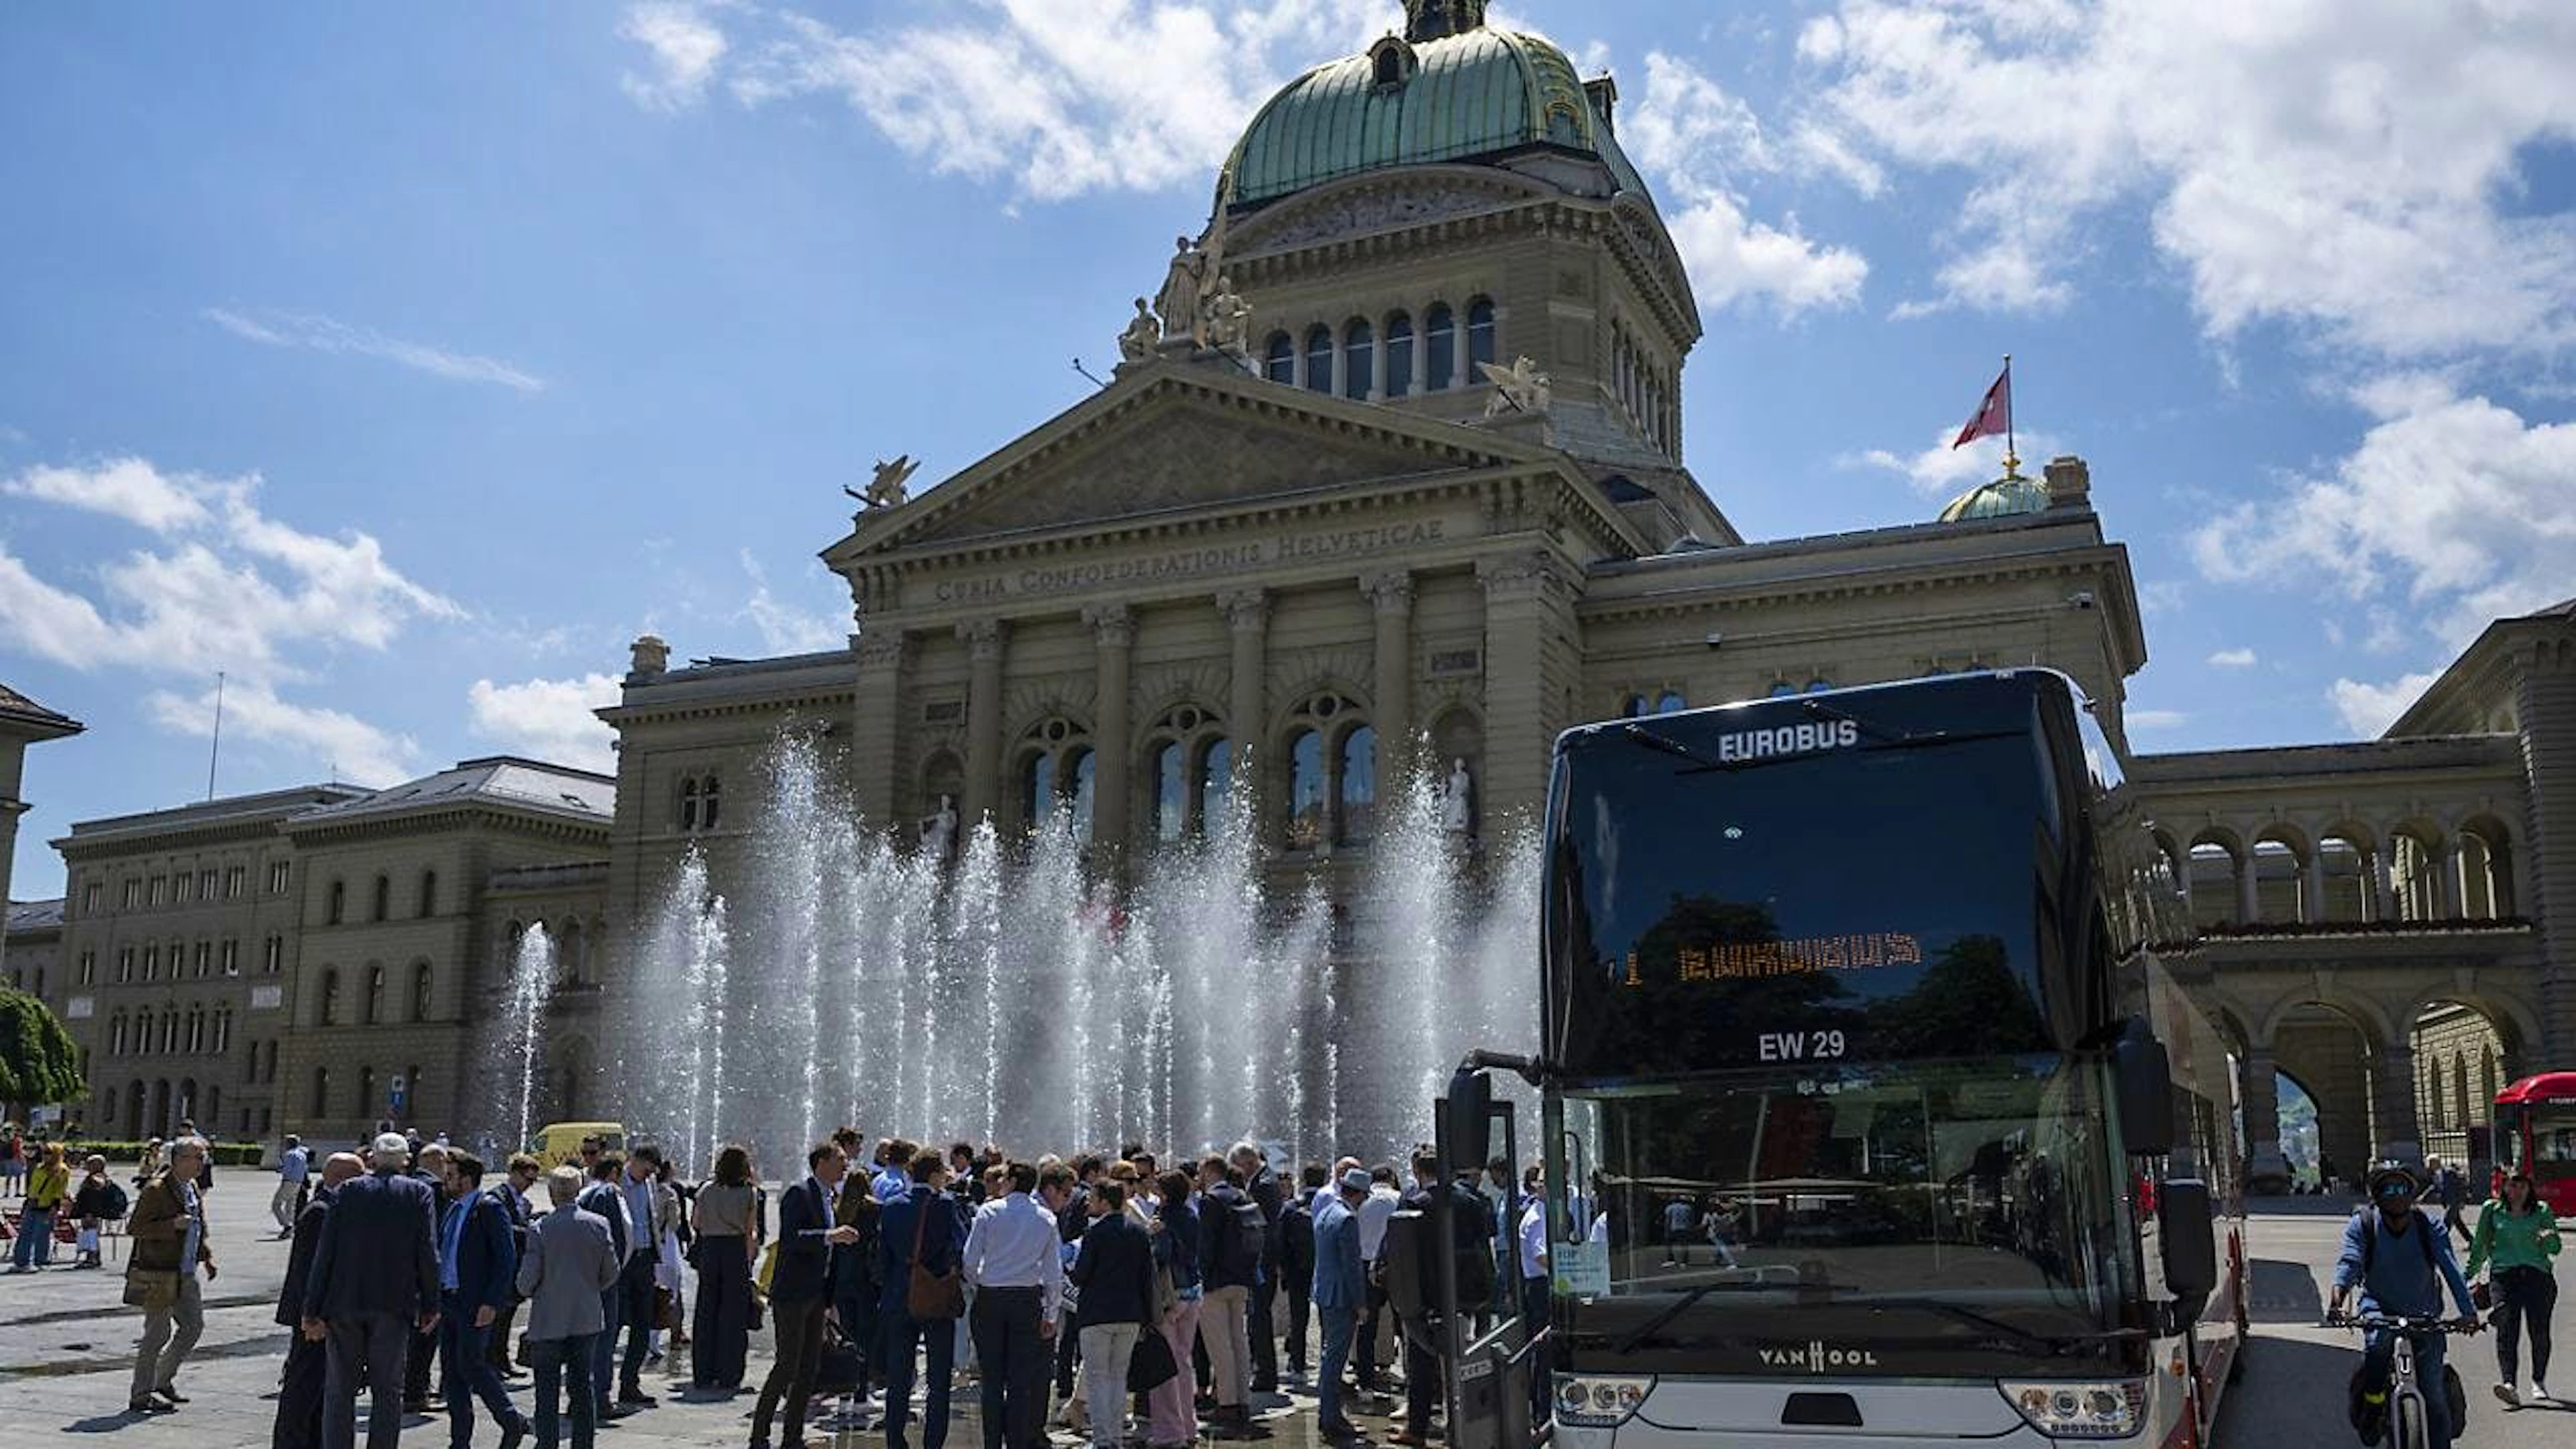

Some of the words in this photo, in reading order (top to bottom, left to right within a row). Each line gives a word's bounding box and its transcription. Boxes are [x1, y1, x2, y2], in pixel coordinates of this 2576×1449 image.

[936, 578, 1006, 601] CURIA
[1020, 542, 1260, 594] CONFOEDERATIONIS
[1279, 520, 1444, 557] HELVETICAE
[1719, 719, 1858, 761] EUROBUS
[1759, 1031, 1805, 1061] EW
[1812, 1029, 1845, 1058] 29
